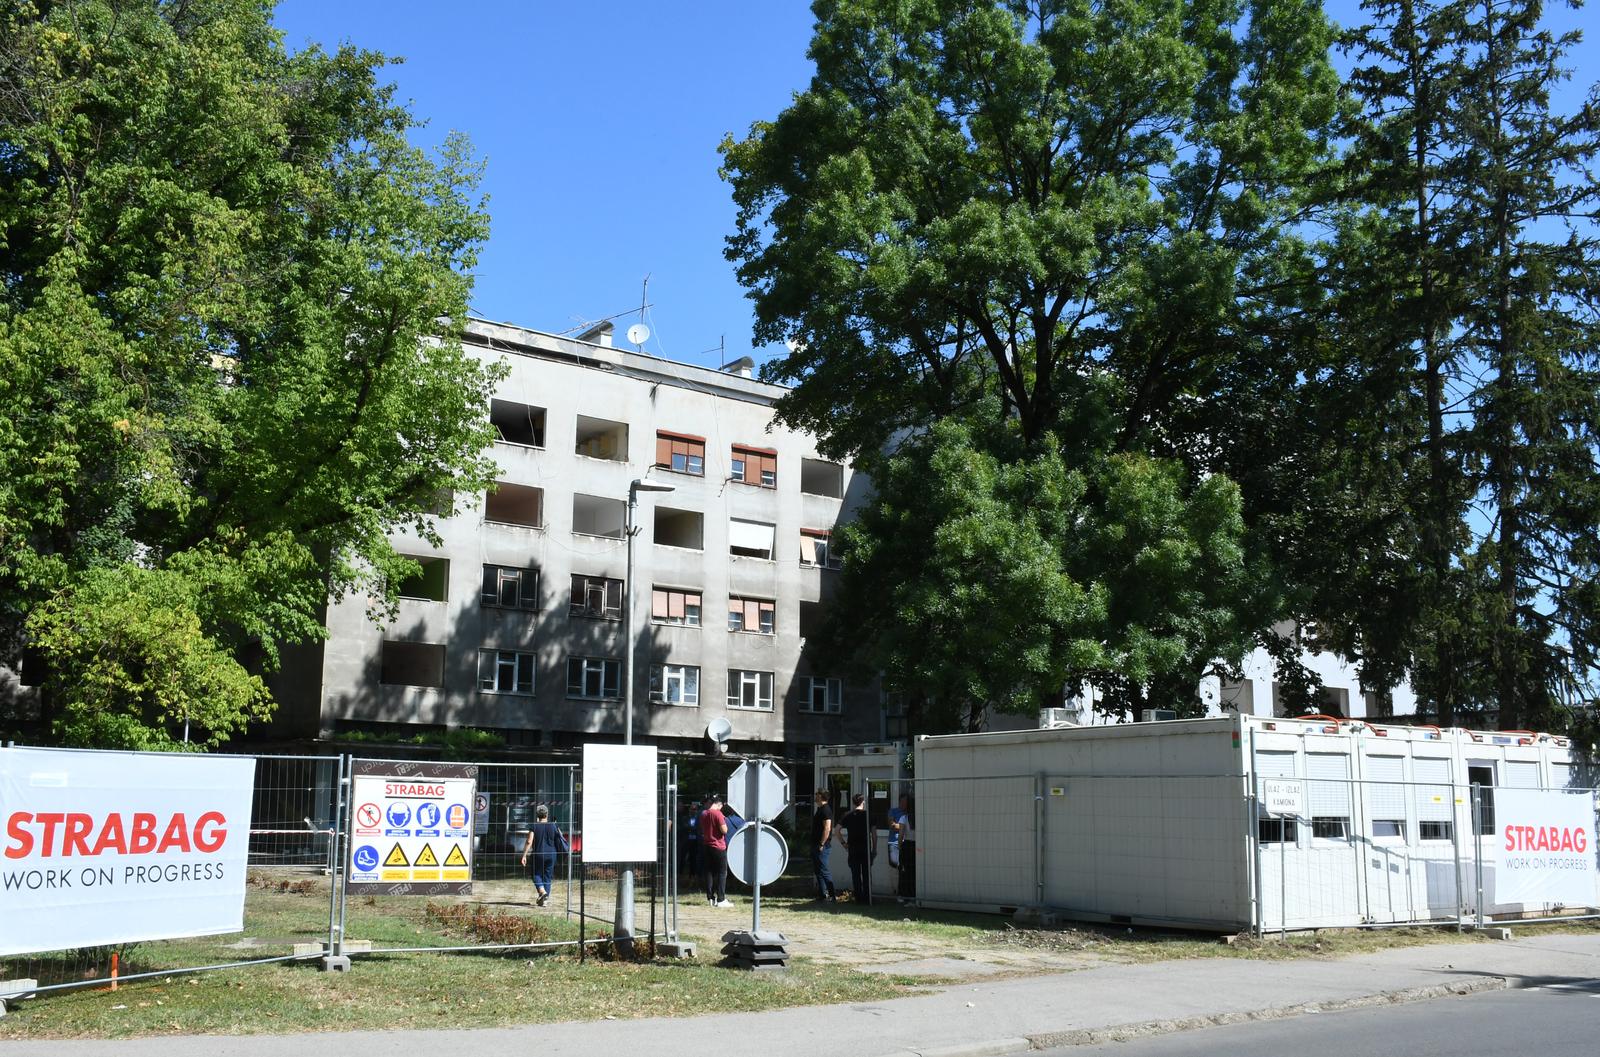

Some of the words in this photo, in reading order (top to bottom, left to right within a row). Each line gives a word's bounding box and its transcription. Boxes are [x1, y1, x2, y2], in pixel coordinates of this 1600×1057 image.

[385, 784, 445, 796] STRABAG
[5, 811, 227, 859] STRABAG
[1505, 825, 1587, 853] STRABAG
[3, 869, 72, 891] WORK
[81, 867, 114, 887] ON
[124, 862, 224, 885] PROGRESS
[1505, 858, 1530, 869] WORK
[1533, 858, 1546, 869] ON
[1549, 858, 1588, 870] PROGRESS
